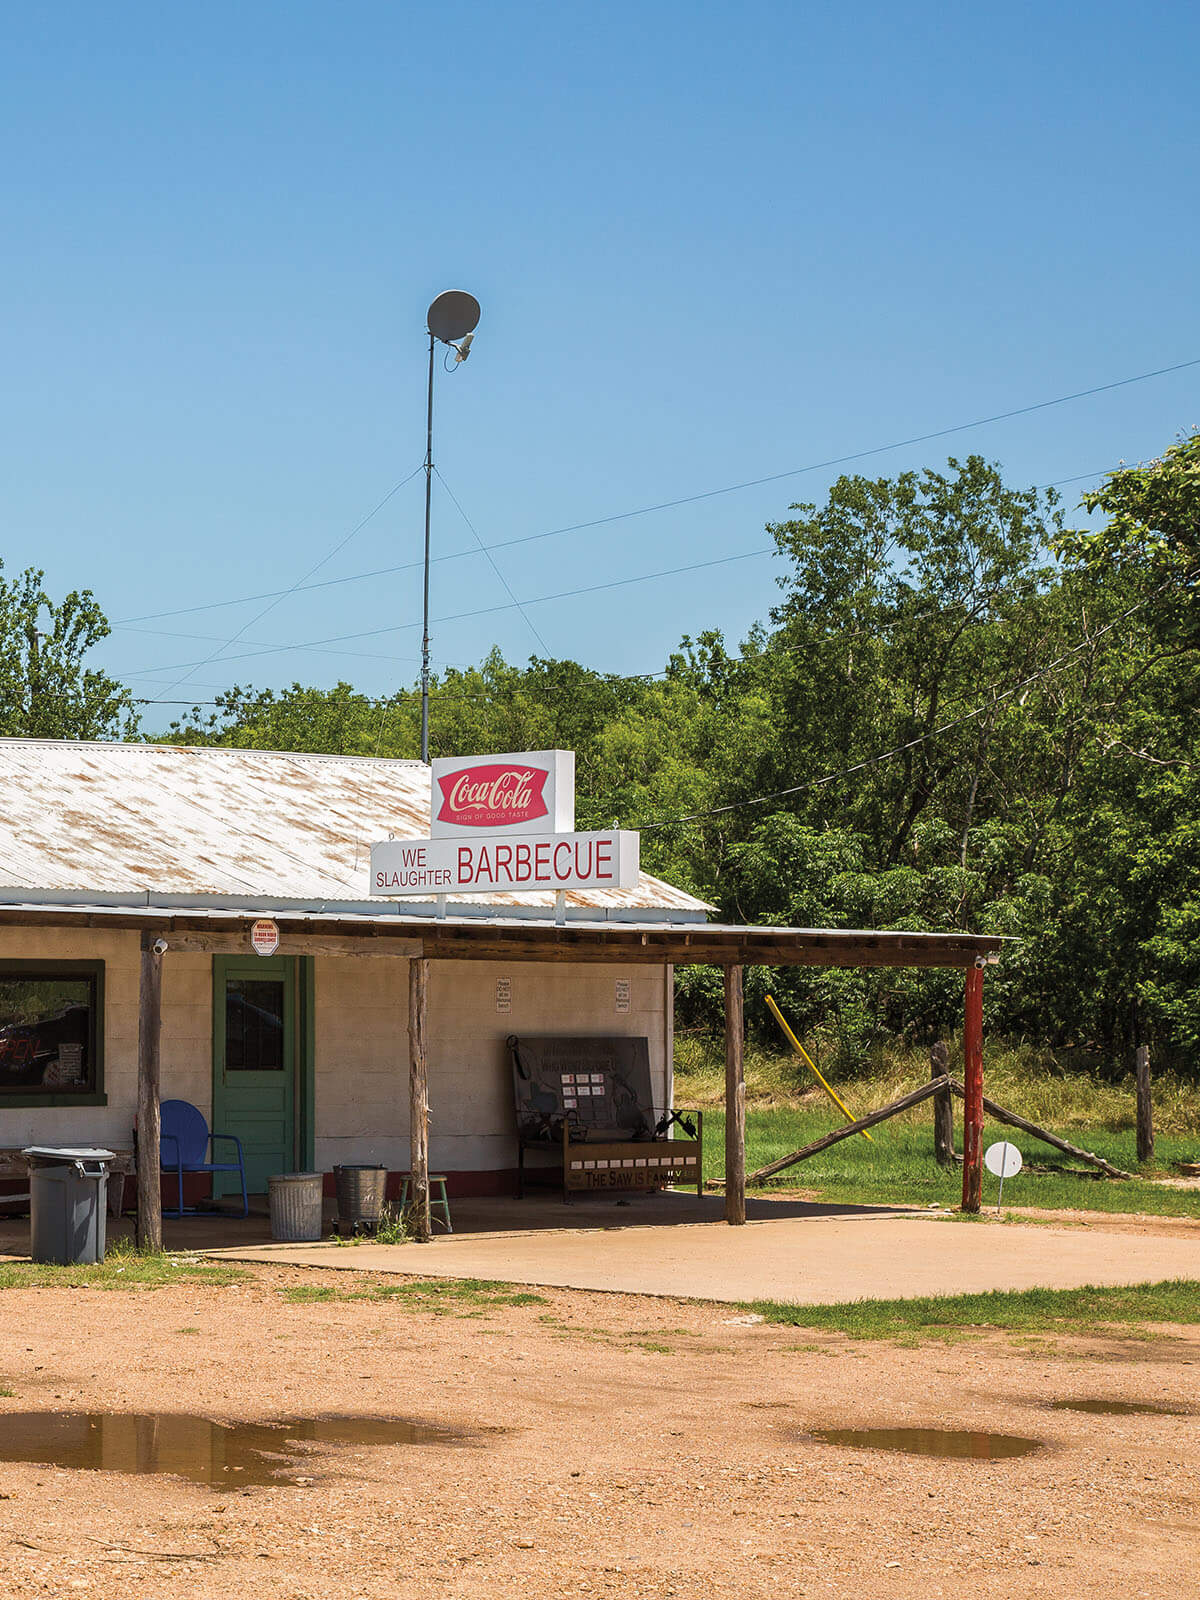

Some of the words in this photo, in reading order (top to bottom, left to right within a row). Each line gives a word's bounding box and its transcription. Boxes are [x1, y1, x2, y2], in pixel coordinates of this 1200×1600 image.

[450, 771, 536, 812] Coca-Cola
[402, 848, 427, 867] WE
[457, 840, 613, 884] BARBECUE
[376, 869, 451, 887] SLAUGHTER
[584, 1171, 607, 1188] THE
[609, 1170, 632, 1186] SAW
